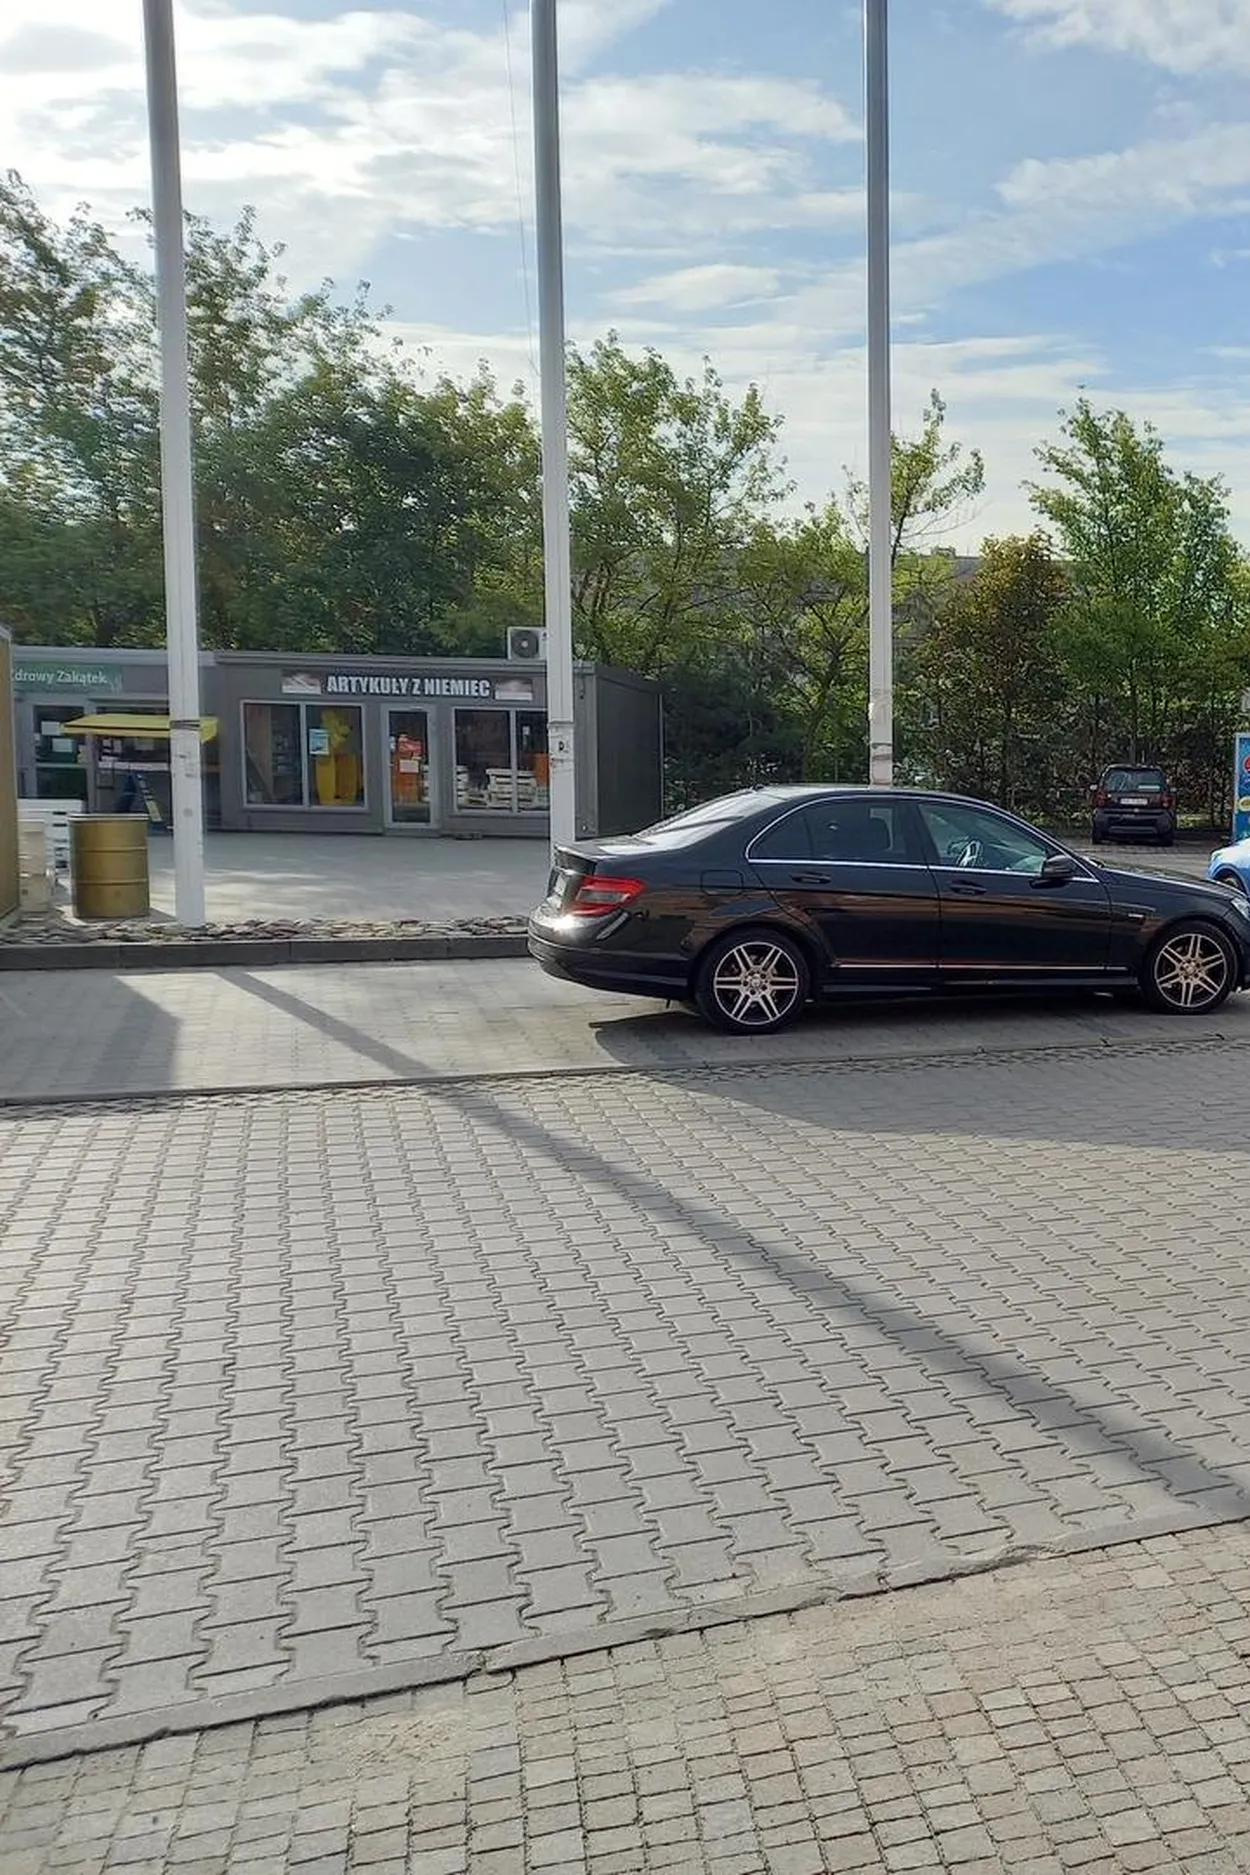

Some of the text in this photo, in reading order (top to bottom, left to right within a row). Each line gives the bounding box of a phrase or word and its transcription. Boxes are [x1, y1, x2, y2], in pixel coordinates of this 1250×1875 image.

[12, 668, 54, 684] drowy
[327, 675, 491, 697] ARTYKUŁY Z NIEMIEC
